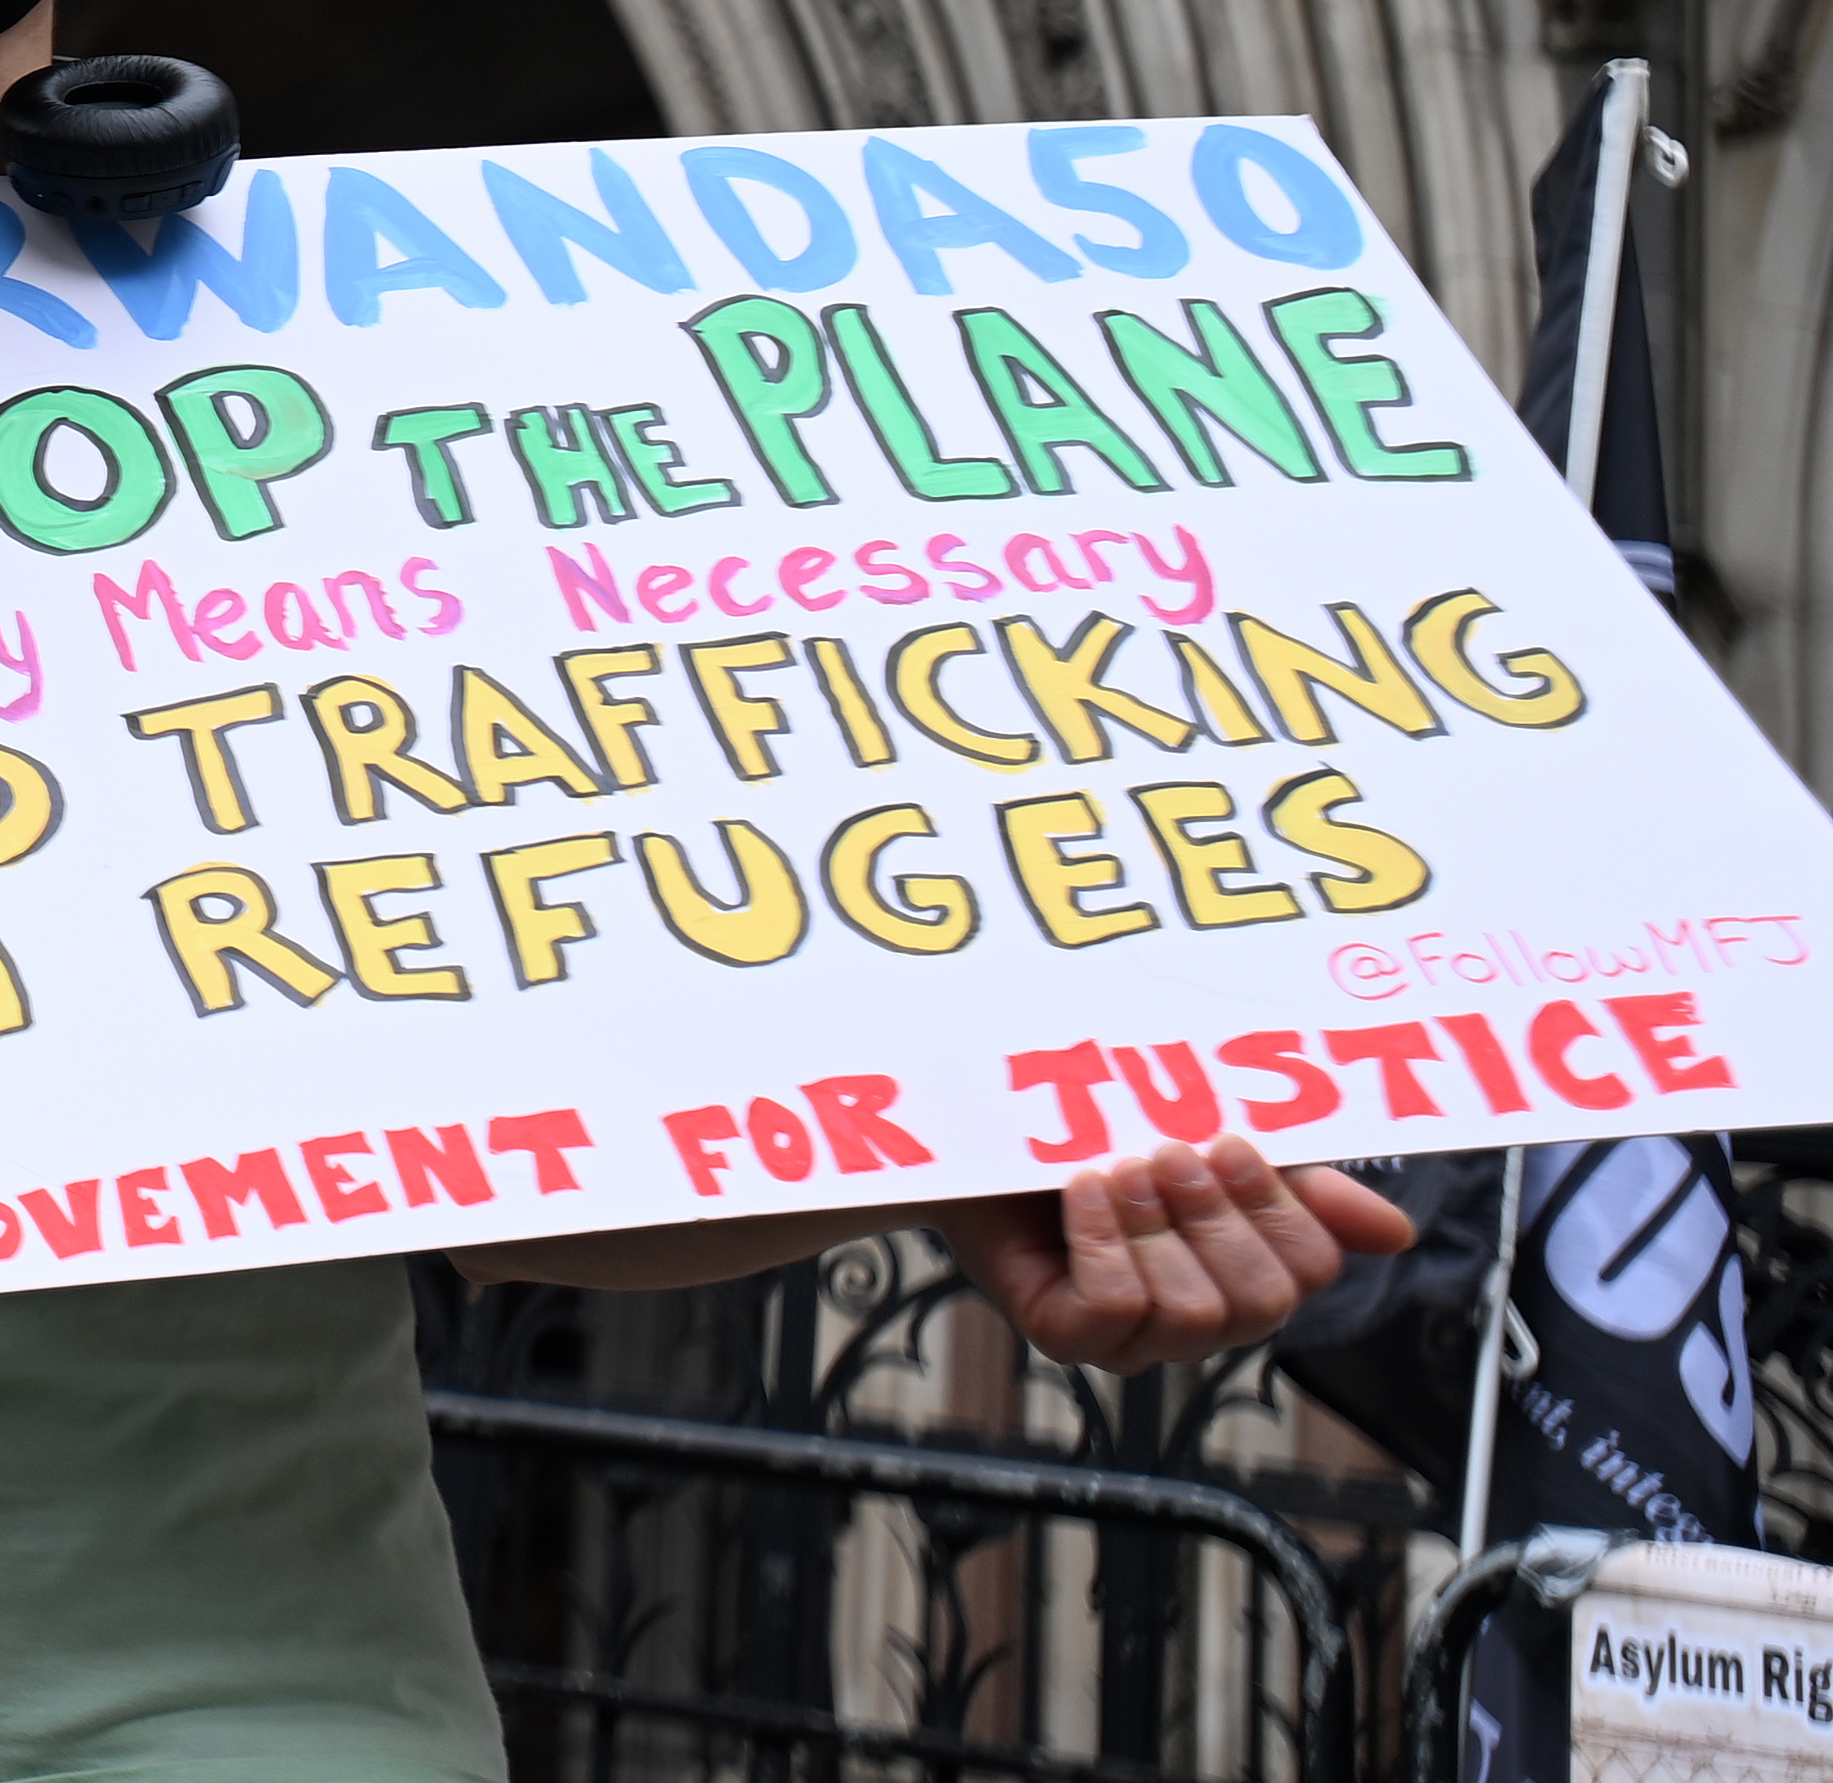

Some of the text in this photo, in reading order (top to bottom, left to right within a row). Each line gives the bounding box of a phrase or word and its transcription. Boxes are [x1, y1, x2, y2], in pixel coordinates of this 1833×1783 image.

[377, 398, 735, 530] THE
[682, 286, 1476, 508] PLANE
[93, 555, 464, 672] Means
[545, 523, 1217, 633] Necessary
[126, 588, 1590, 835] TRAFFICKING
[141, 762, 1432, 1018] REFUGEES
[663, 1073, 933, 1198] FOR
[1007, 990, 1740, 1165] JUSTICE
[1590, 1628, 1745, 1697] Asylum
